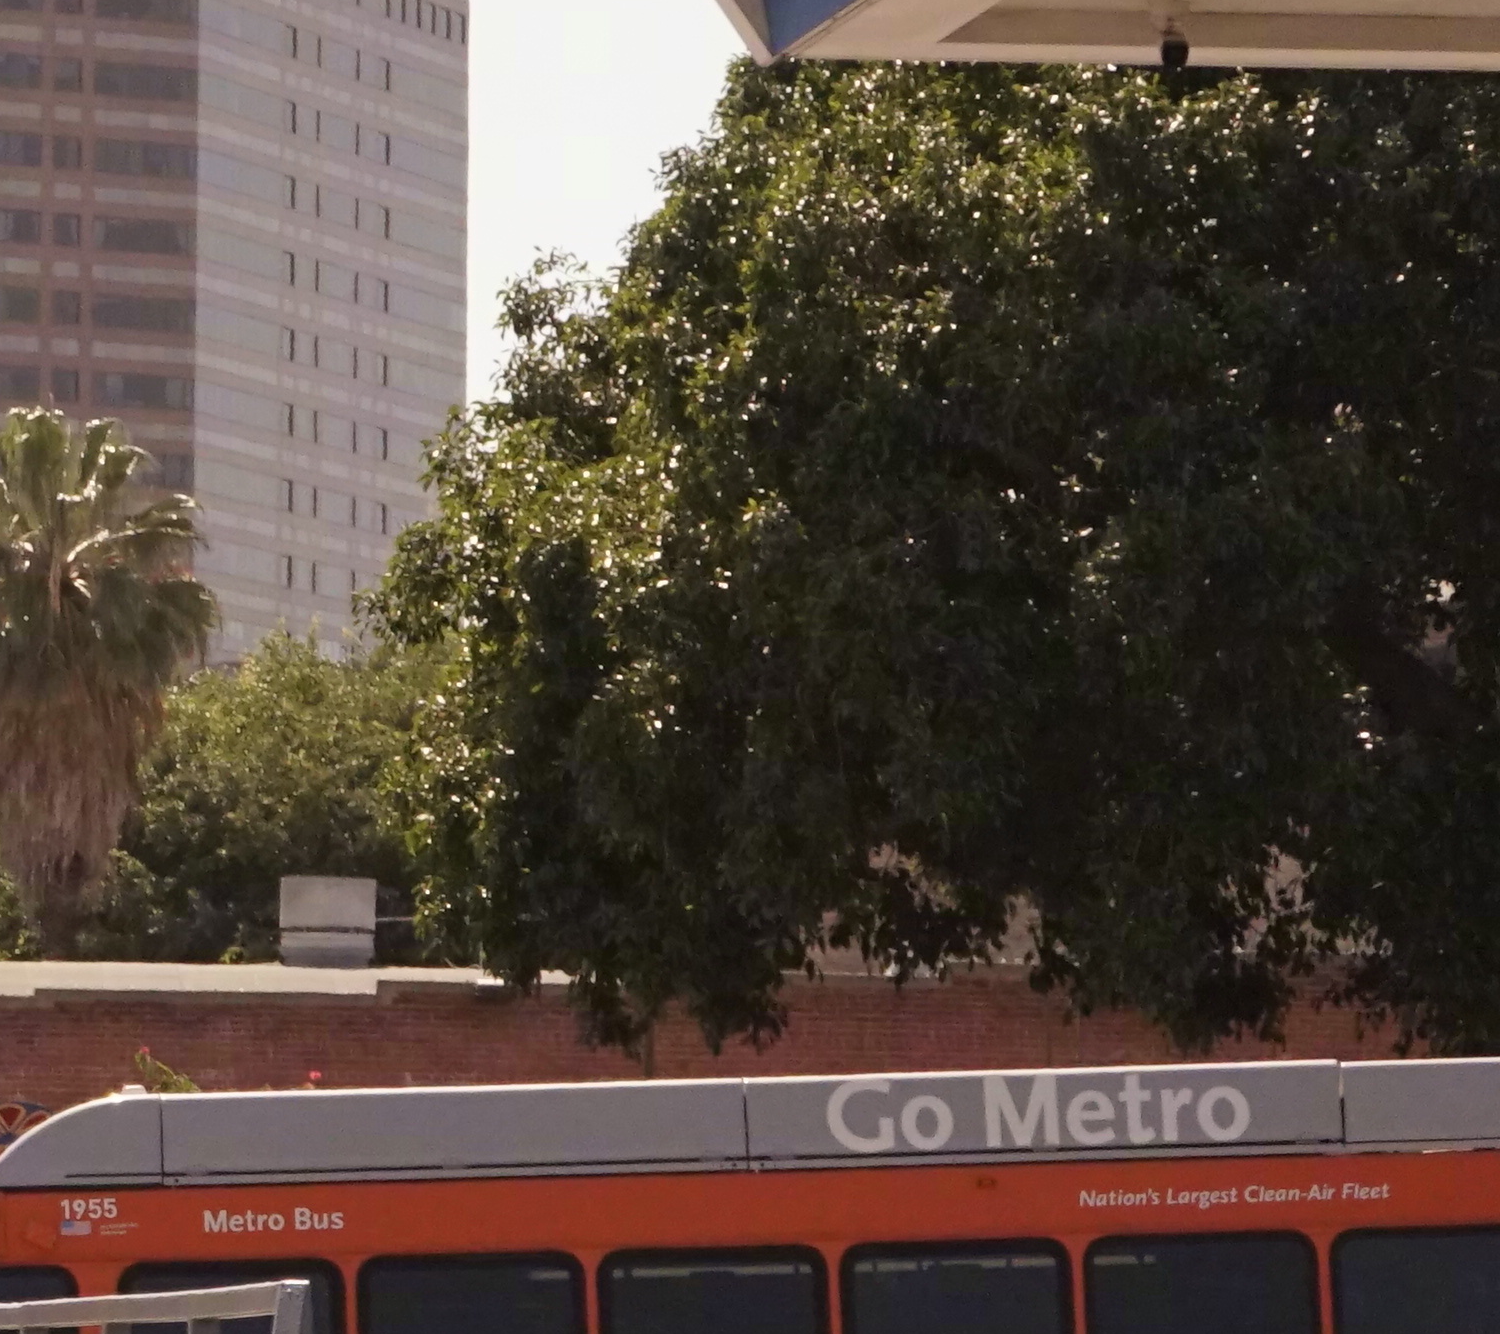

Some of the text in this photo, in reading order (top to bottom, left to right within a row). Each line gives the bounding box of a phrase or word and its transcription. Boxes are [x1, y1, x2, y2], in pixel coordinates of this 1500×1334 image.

[824, 1073, 1253, 1154] Go Metro
[1078, 1182, 1391, 1208] Nation's Largest Clean-Air Fleet
[60, 1198, 118, 1220] 1955
[203, 1207, 345, 1234] Metro Bus
